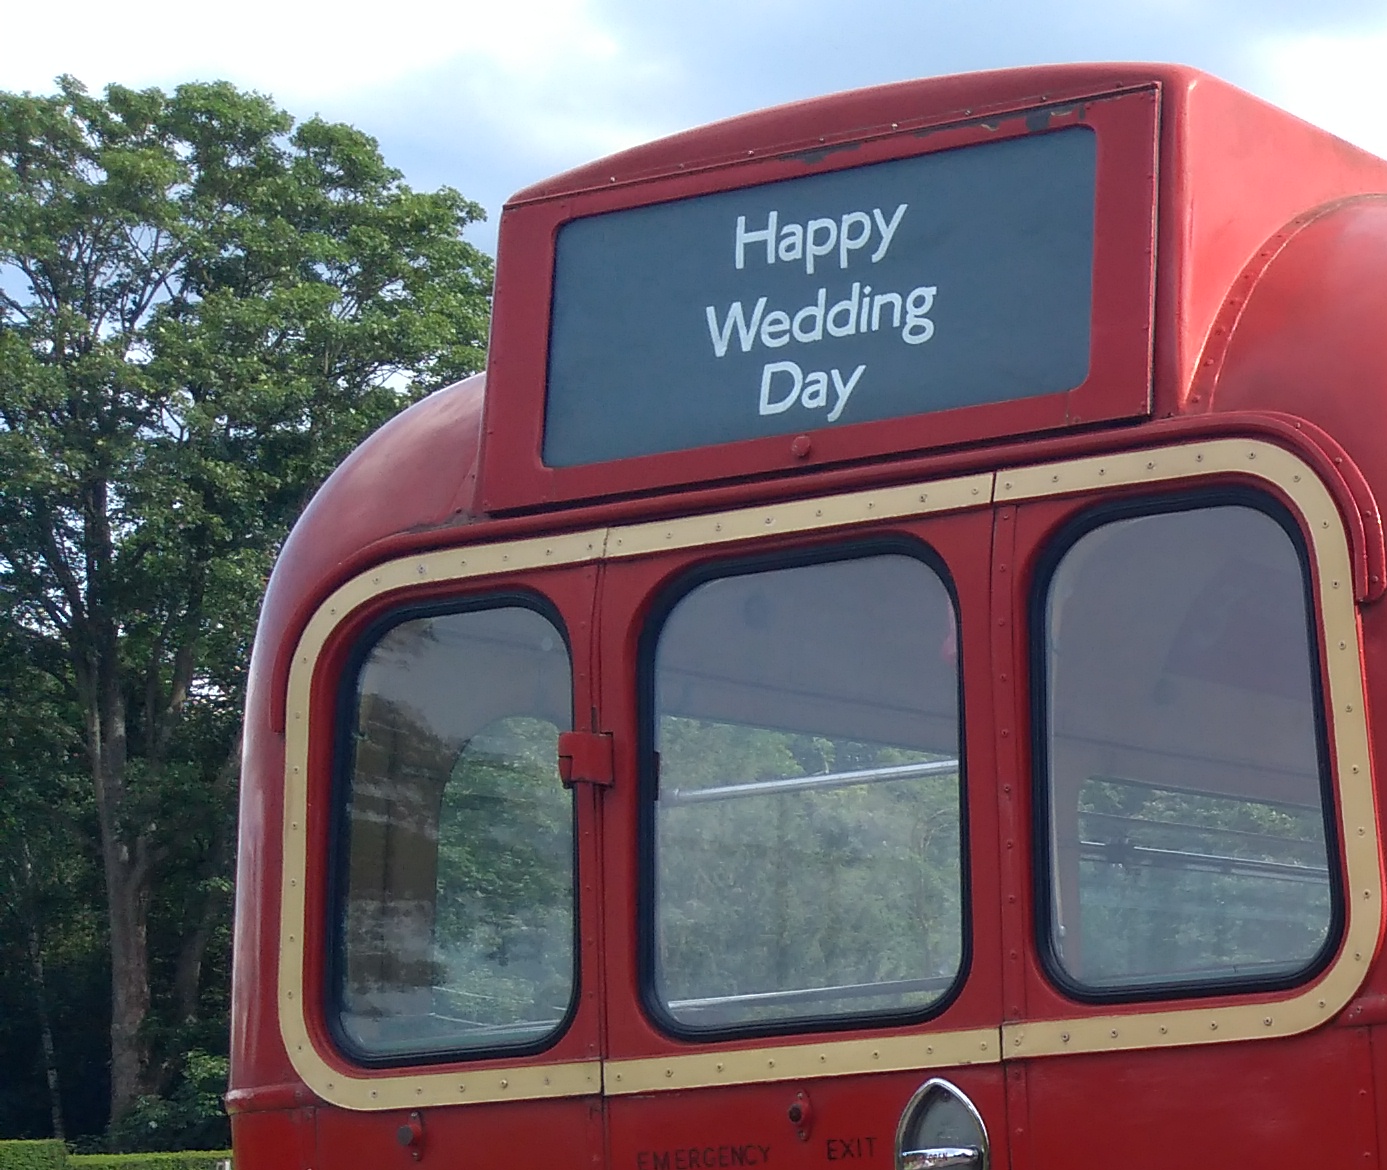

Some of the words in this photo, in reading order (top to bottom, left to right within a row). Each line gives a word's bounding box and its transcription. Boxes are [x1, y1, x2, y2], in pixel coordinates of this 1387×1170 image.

[734, 203, 909, 275] Happy
[705, 281, 938, 357] Wedding
[758, 360, 866, 422] Day
[826, 1136, 879, 1162] EXIT
